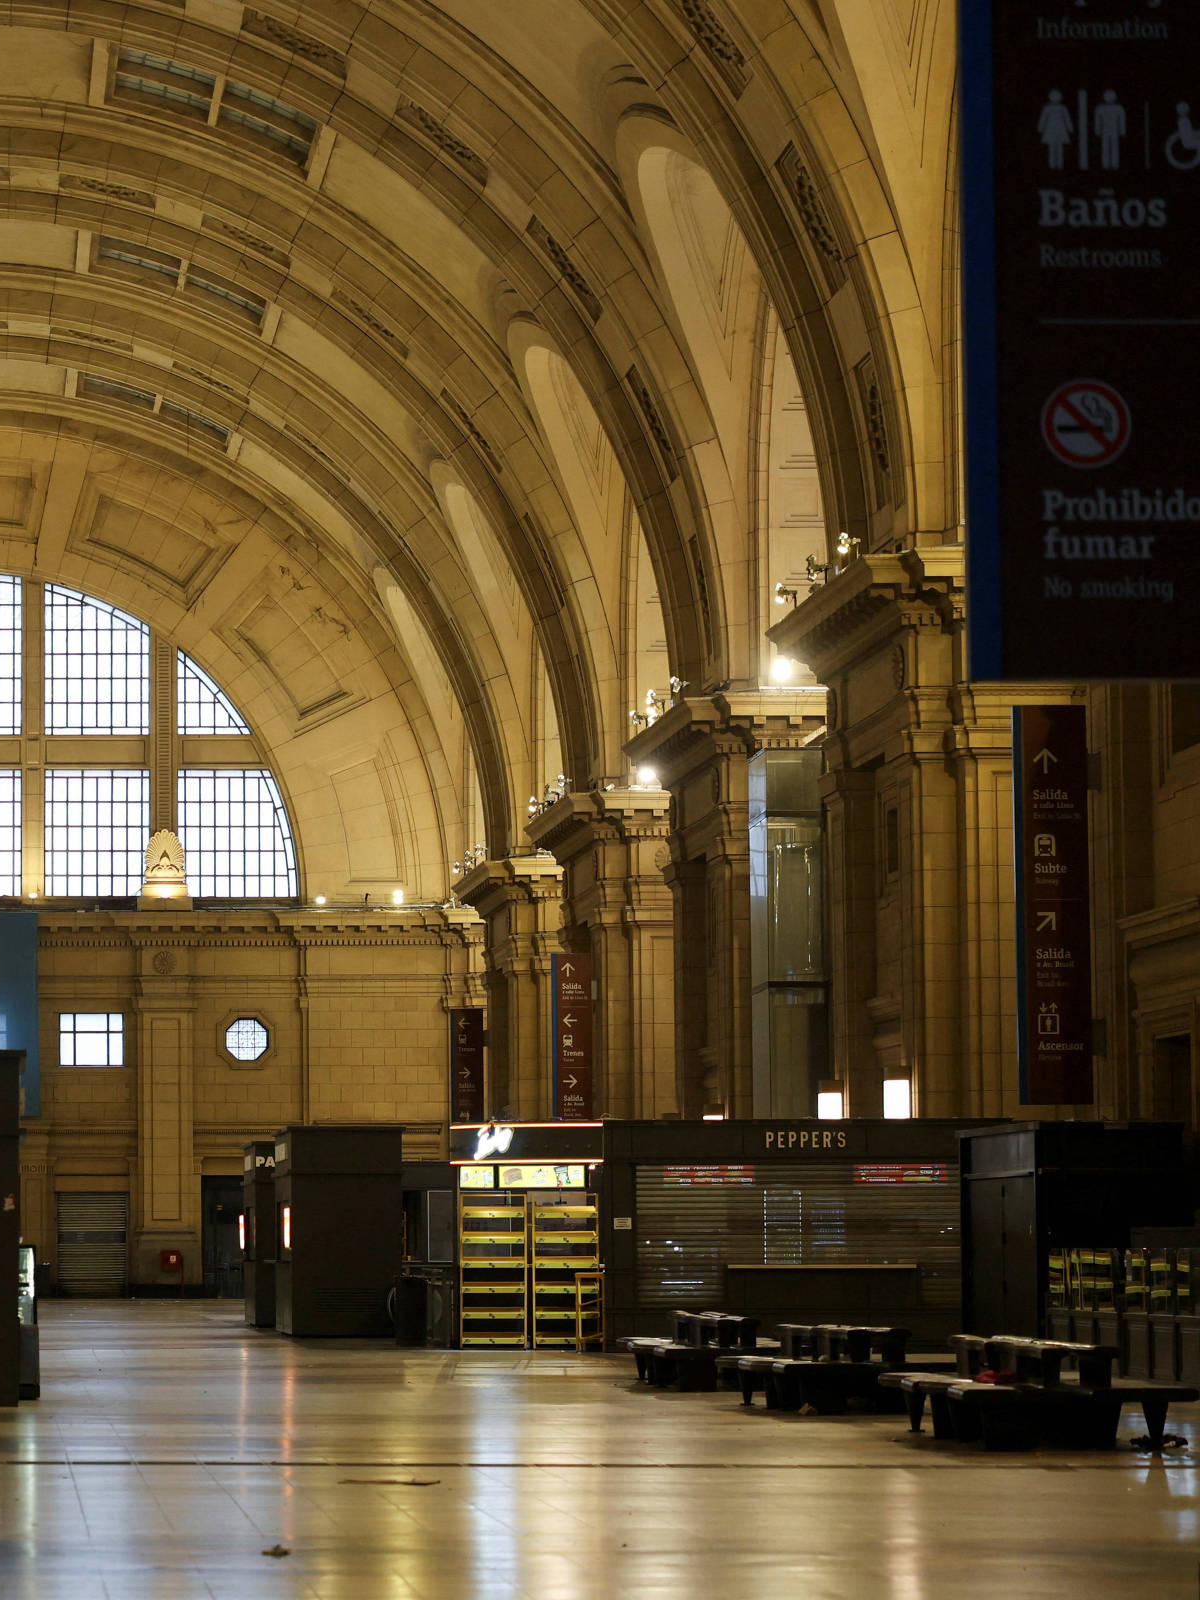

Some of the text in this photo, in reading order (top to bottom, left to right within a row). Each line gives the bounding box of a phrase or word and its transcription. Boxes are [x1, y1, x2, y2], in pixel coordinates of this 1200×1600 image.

[1036, 17, 1169, 40] Information
[1039, 188, 1168, 228] Baños
[1040, 245, 1163, 268] Restrooms
[1043, 527, 1156, 560] fumar
[1044, 577, 1176, 604] No smoking
[1033, 788, 1070, 800] Salida
[1034, 863, 1069, 874] Subte
[1036, 948, 1072, 960] Salida
[562, 982, 582, 990] Salida
[1038, 1041, 1085, 1051] Ascensor
[563, 1049, 584, 1058] Trenes
[563, 1094, 583, 1102] Salida
[765, 1130, 847, 1149] PEPPER'S
